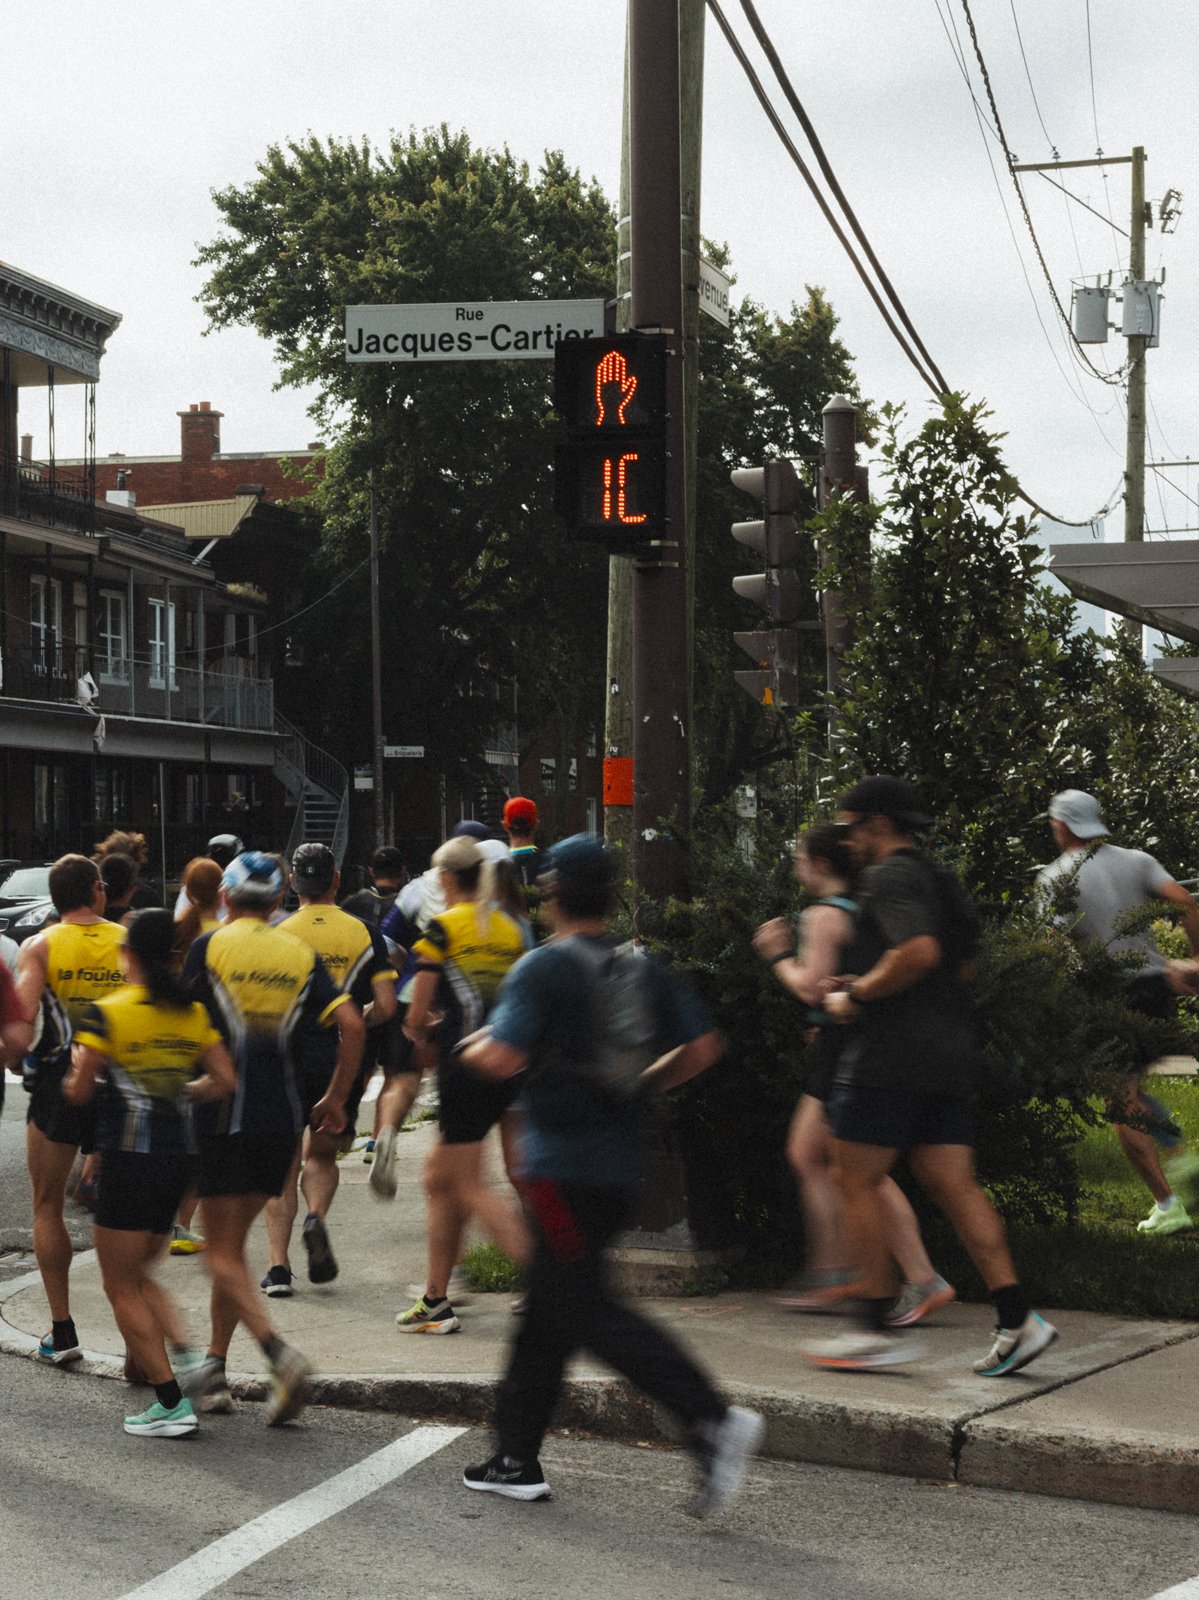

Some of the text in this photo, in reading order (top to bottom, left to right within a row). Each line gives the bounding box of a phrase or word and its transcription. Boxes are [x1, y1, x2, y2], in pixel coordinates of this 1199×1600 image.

[699, 276, 728, 313] venue
[455, 307, 484, 321] Rue
[348, 323, 594, 358] Jacques-Cartier
[58, 969, 73, 980] la
